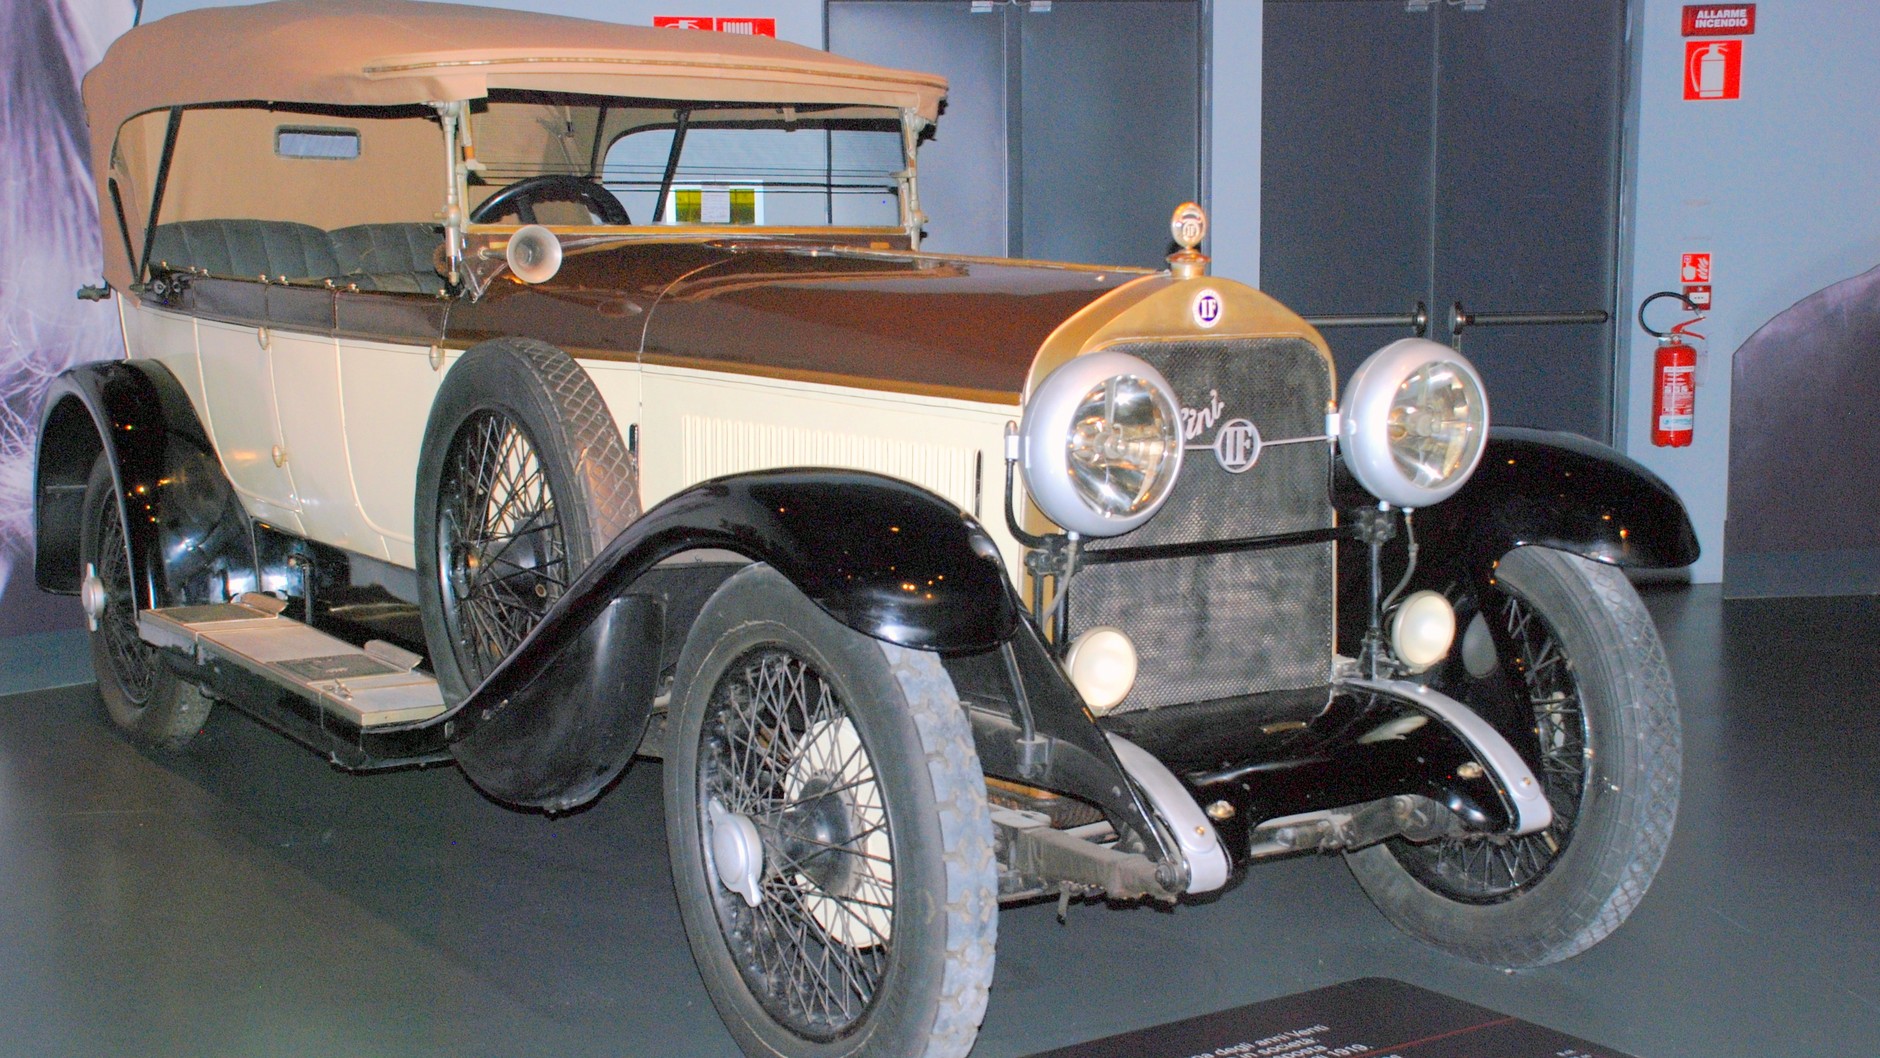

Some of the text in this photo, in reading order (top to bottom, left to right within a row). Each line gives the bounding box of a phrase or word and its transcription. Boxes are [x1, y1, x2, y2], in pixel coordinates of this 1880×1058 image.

[1697, 9, 1747, 18] ALLARME
[1695, 18, 1748, 28] INCENDIO
[1201, 299, 1217, 319] IF
[1222, 426, 1252, 466] IF
[1214, 1024, 1330, 1056] degli anni Venti
[1327, 1044, 1374, 1057] 1919.
